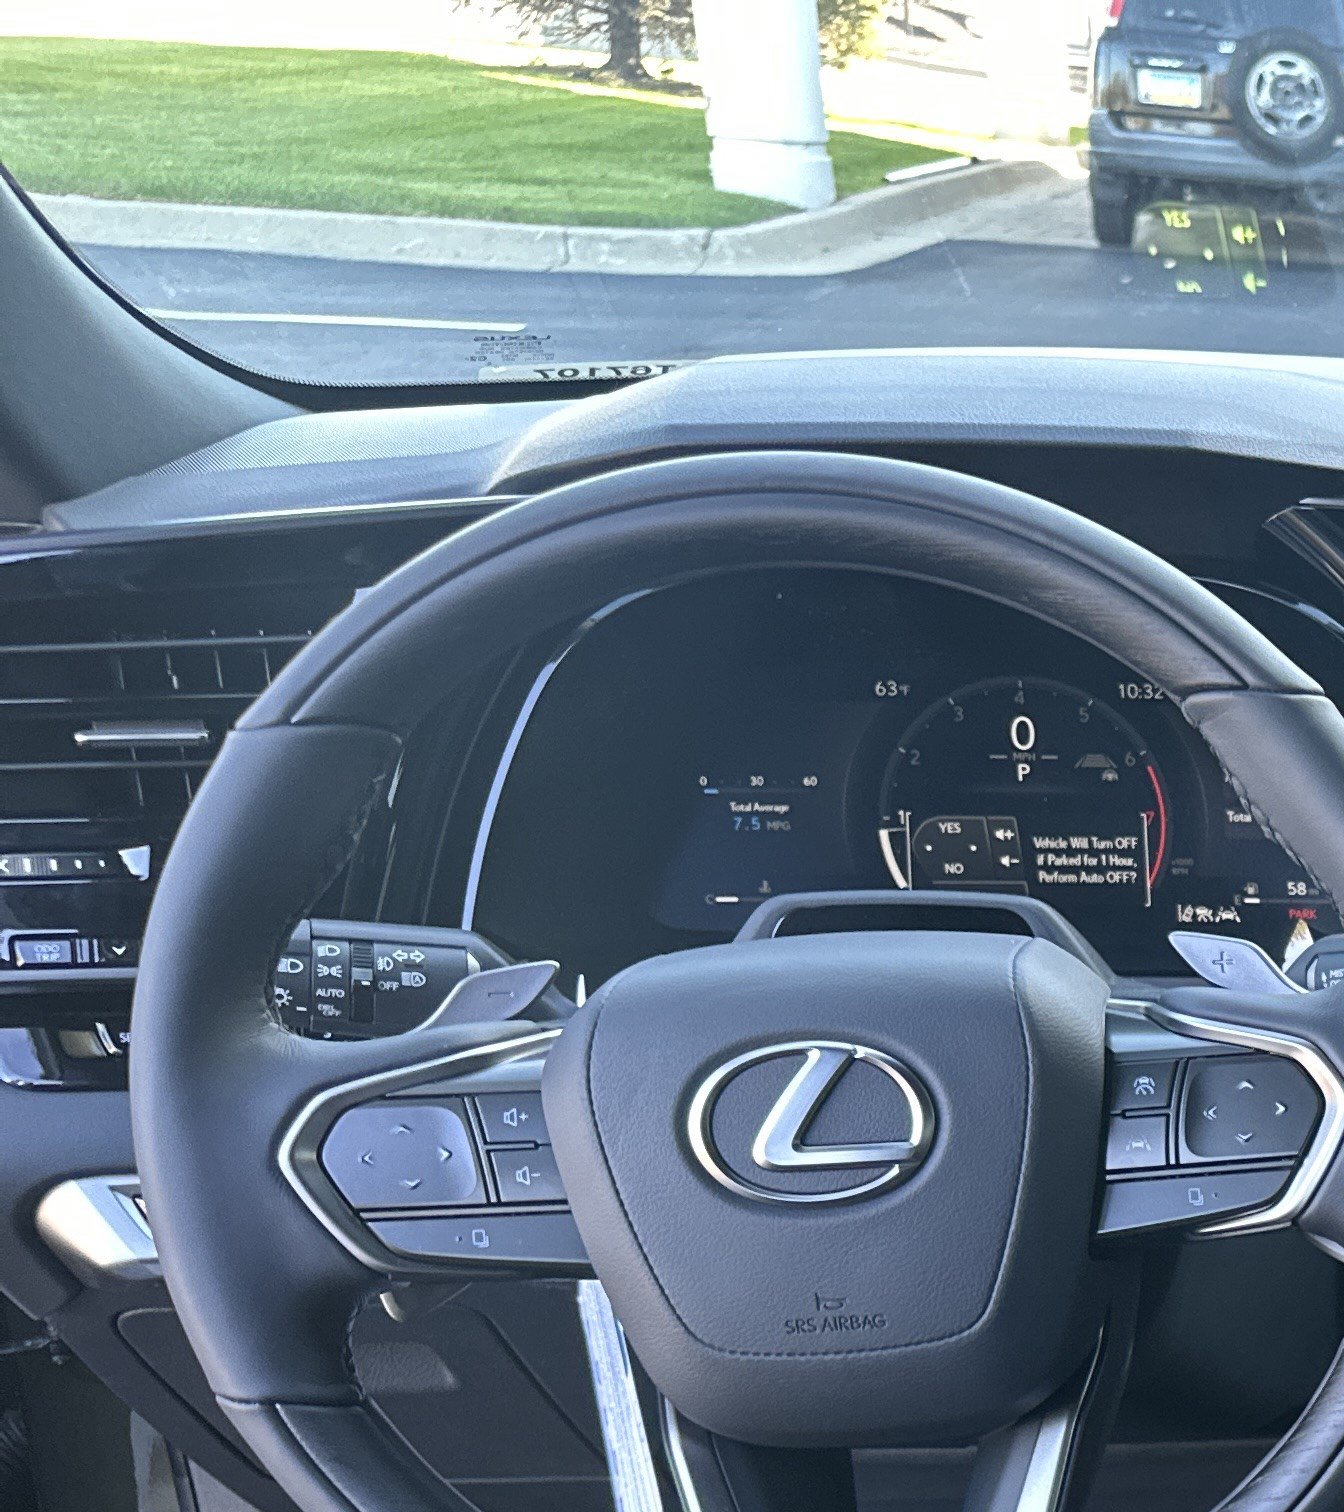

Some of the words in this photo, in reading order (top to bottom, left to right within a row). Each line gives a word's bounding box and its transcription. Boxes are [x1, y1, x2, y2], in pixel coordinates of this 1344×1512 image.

[1162, 209, 1191, 228] YES
[1118, 682, 1165, 701] 10:32
[953, 705, 965, 723] 3
[1078, 706, 1091, 724] 5
[1009, 714, 1037, 751] 0
[909, 749, 922, 766] 2
[1124, 752, 1137, 767] 6
[699, 775, 708, 787] 0
[750, 775, 765, 787] 30
[802, 775, 818, 787] 60
[1016, 763, 1032, 783] P
[729, 801, 752, 813] Total
[753, 802, 790, 815] Average
[733, 815, 761, 831] 7.5
[938, 821, 963, 834] YES
[1033, 836, 1068, 850] Vehicle
[1070, 836, 1090, 850] Will
[1091, 837, 1114, 850] Turn
[1115, 837, 1139, 850] OFF
[944, 862, 965, 875] NO
[1048, 852, 1080, 867] Parked
[1083, 853, 1100, 867] for
[1101, 853, 1108, 867] 1
[1109, 853, 1138, 869] Hour,
[1038, 869, 1078, 884] Perform
[1079, 870, 1105, 885] Auto
[1107, 871, 1138, 885] OFF?
[1286, 880, 1308, 897] 58
[1287, 907, 1318, 921] PARK
[315, 988, 345, 999] AUTO
[377, 980, 400, 992] OFF
[784, 1317, 818, 1336] SRS
[821, 1312, 887, 1334] AIRBAG
